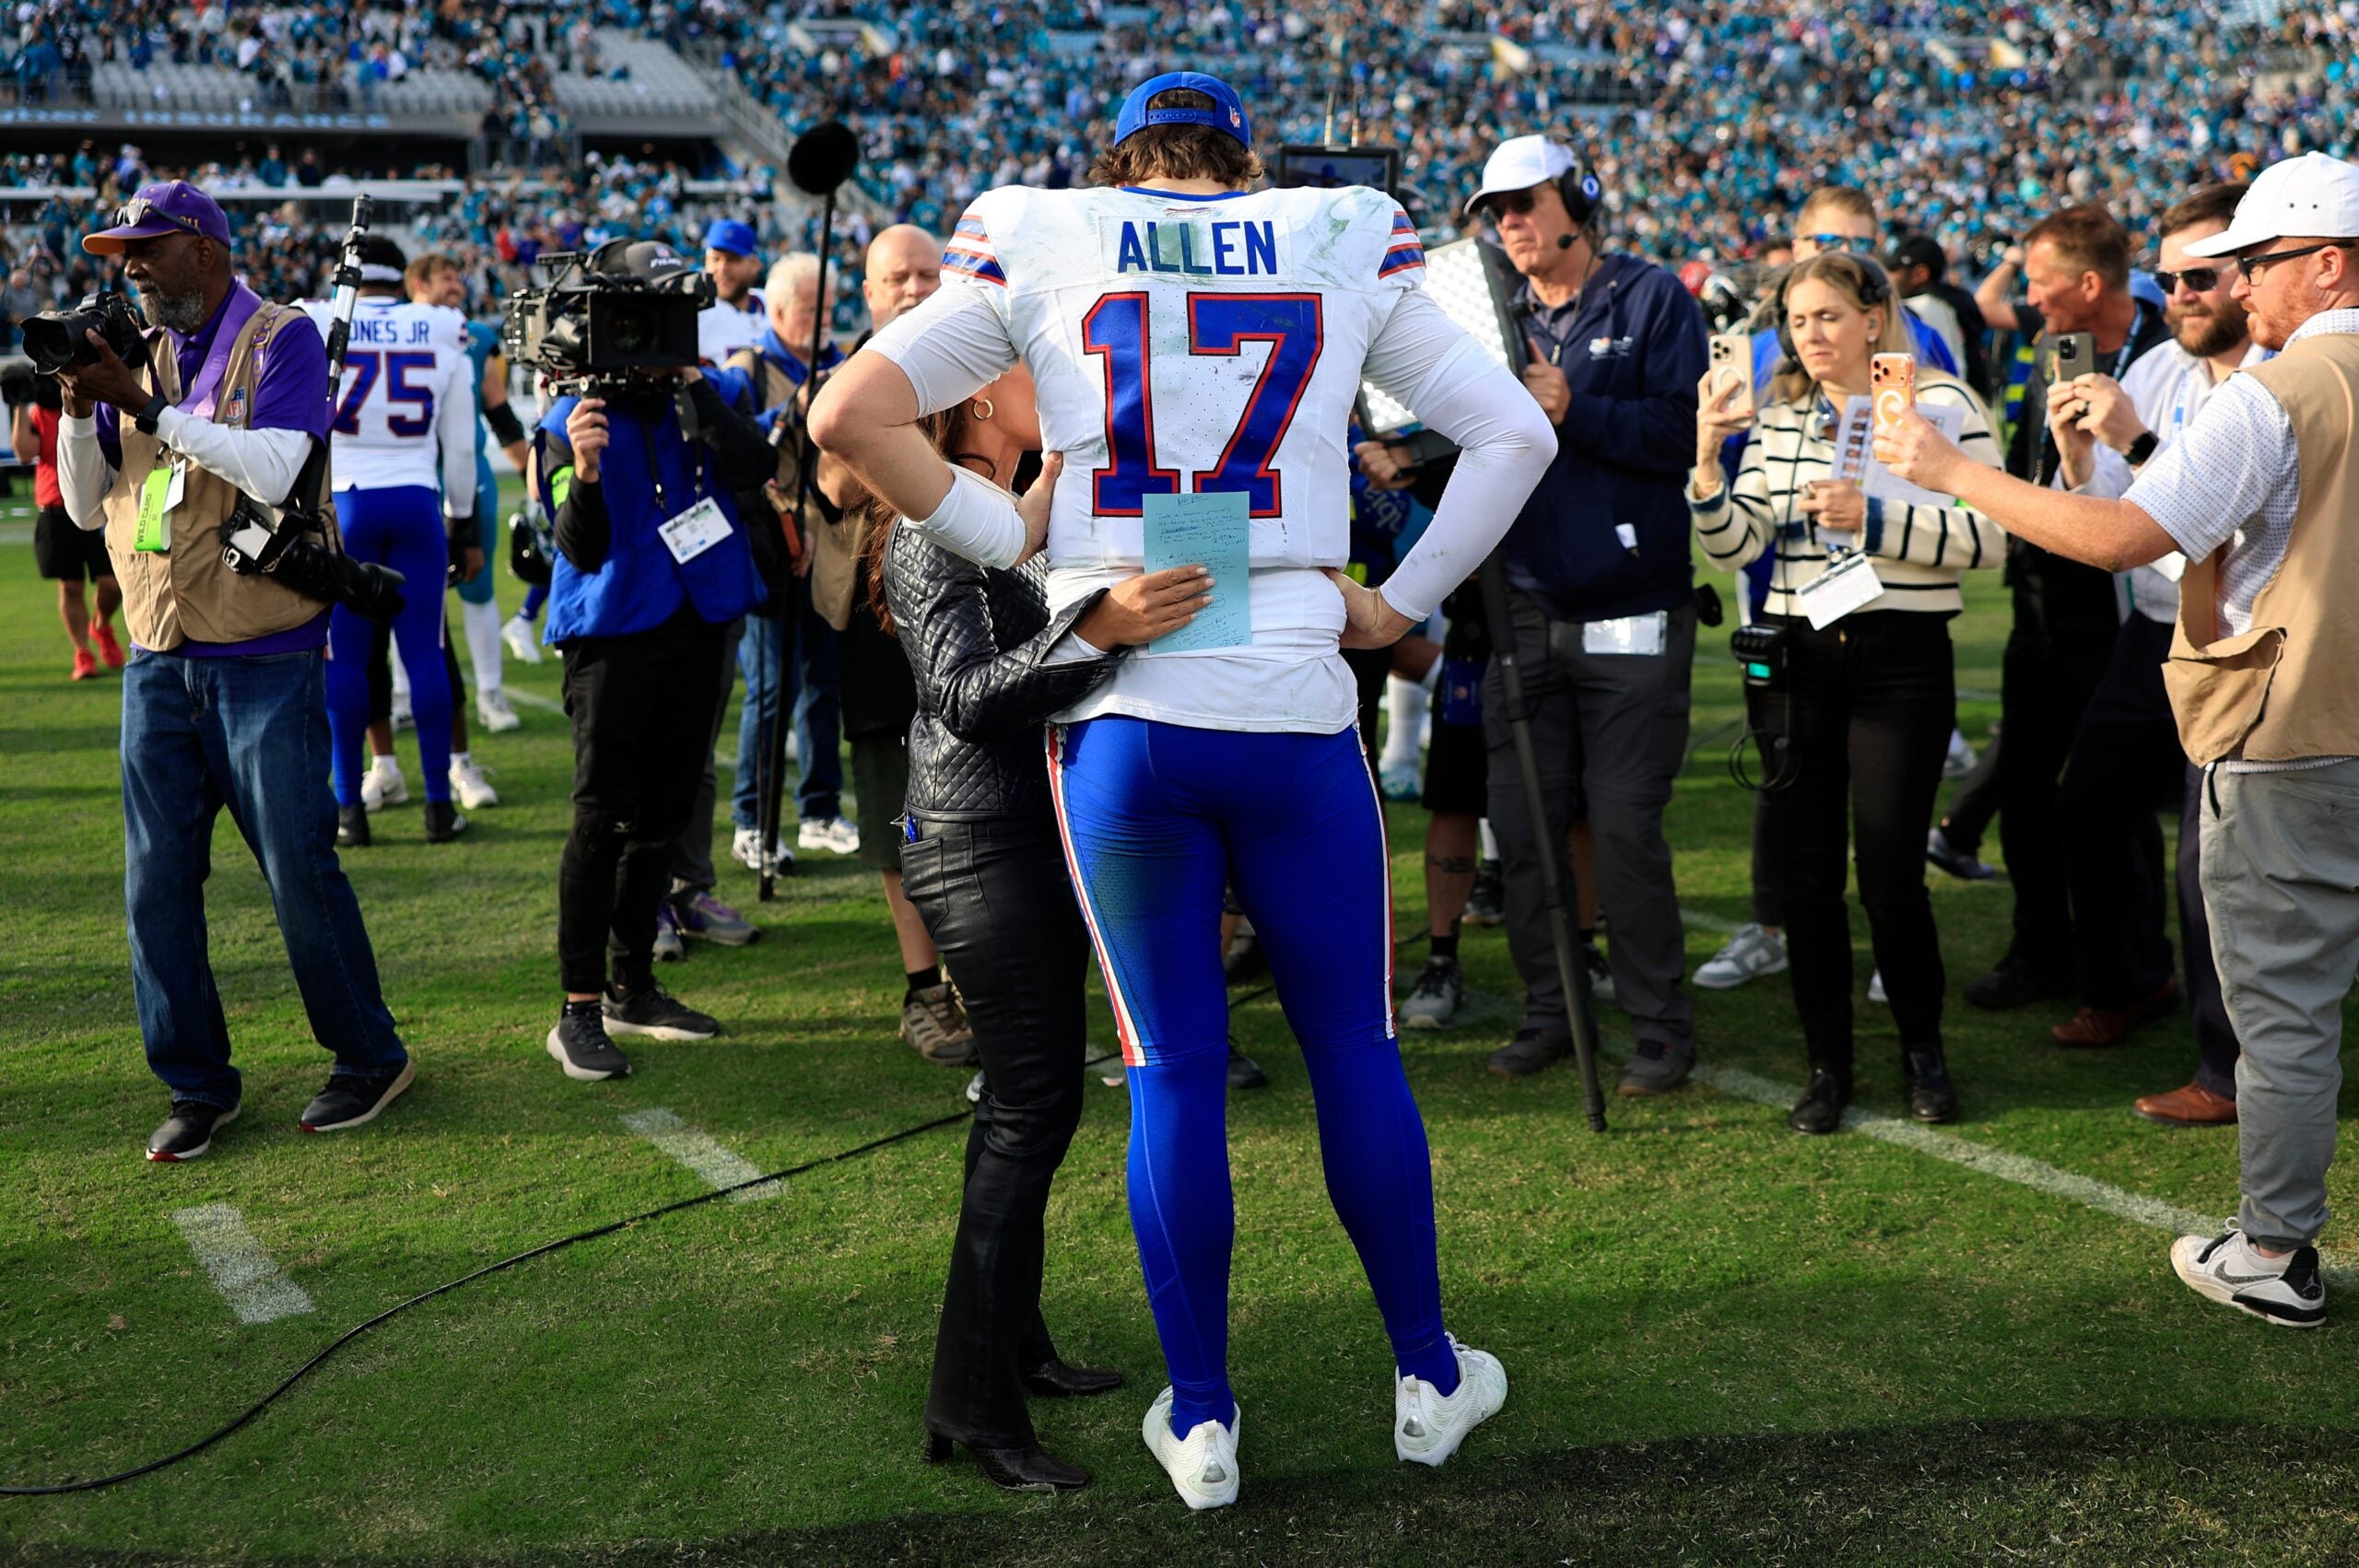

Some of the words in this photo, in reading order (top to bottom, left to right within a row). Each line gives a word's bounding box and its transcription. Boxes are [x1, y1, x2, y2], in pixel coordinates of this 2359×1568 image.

[124, 109, 391, 128] INSURANCE
[1117, 220, 1278, 275] ALLEN
[348, 320, 397, 343] ONES
[405, 321, 429, 344] JR
[333, 350, 436, 438] 75
[1081, 290, 1325, 520] 17
[141, 493, 152, 519] CARD
[136, 520, 147, 544] WILD
